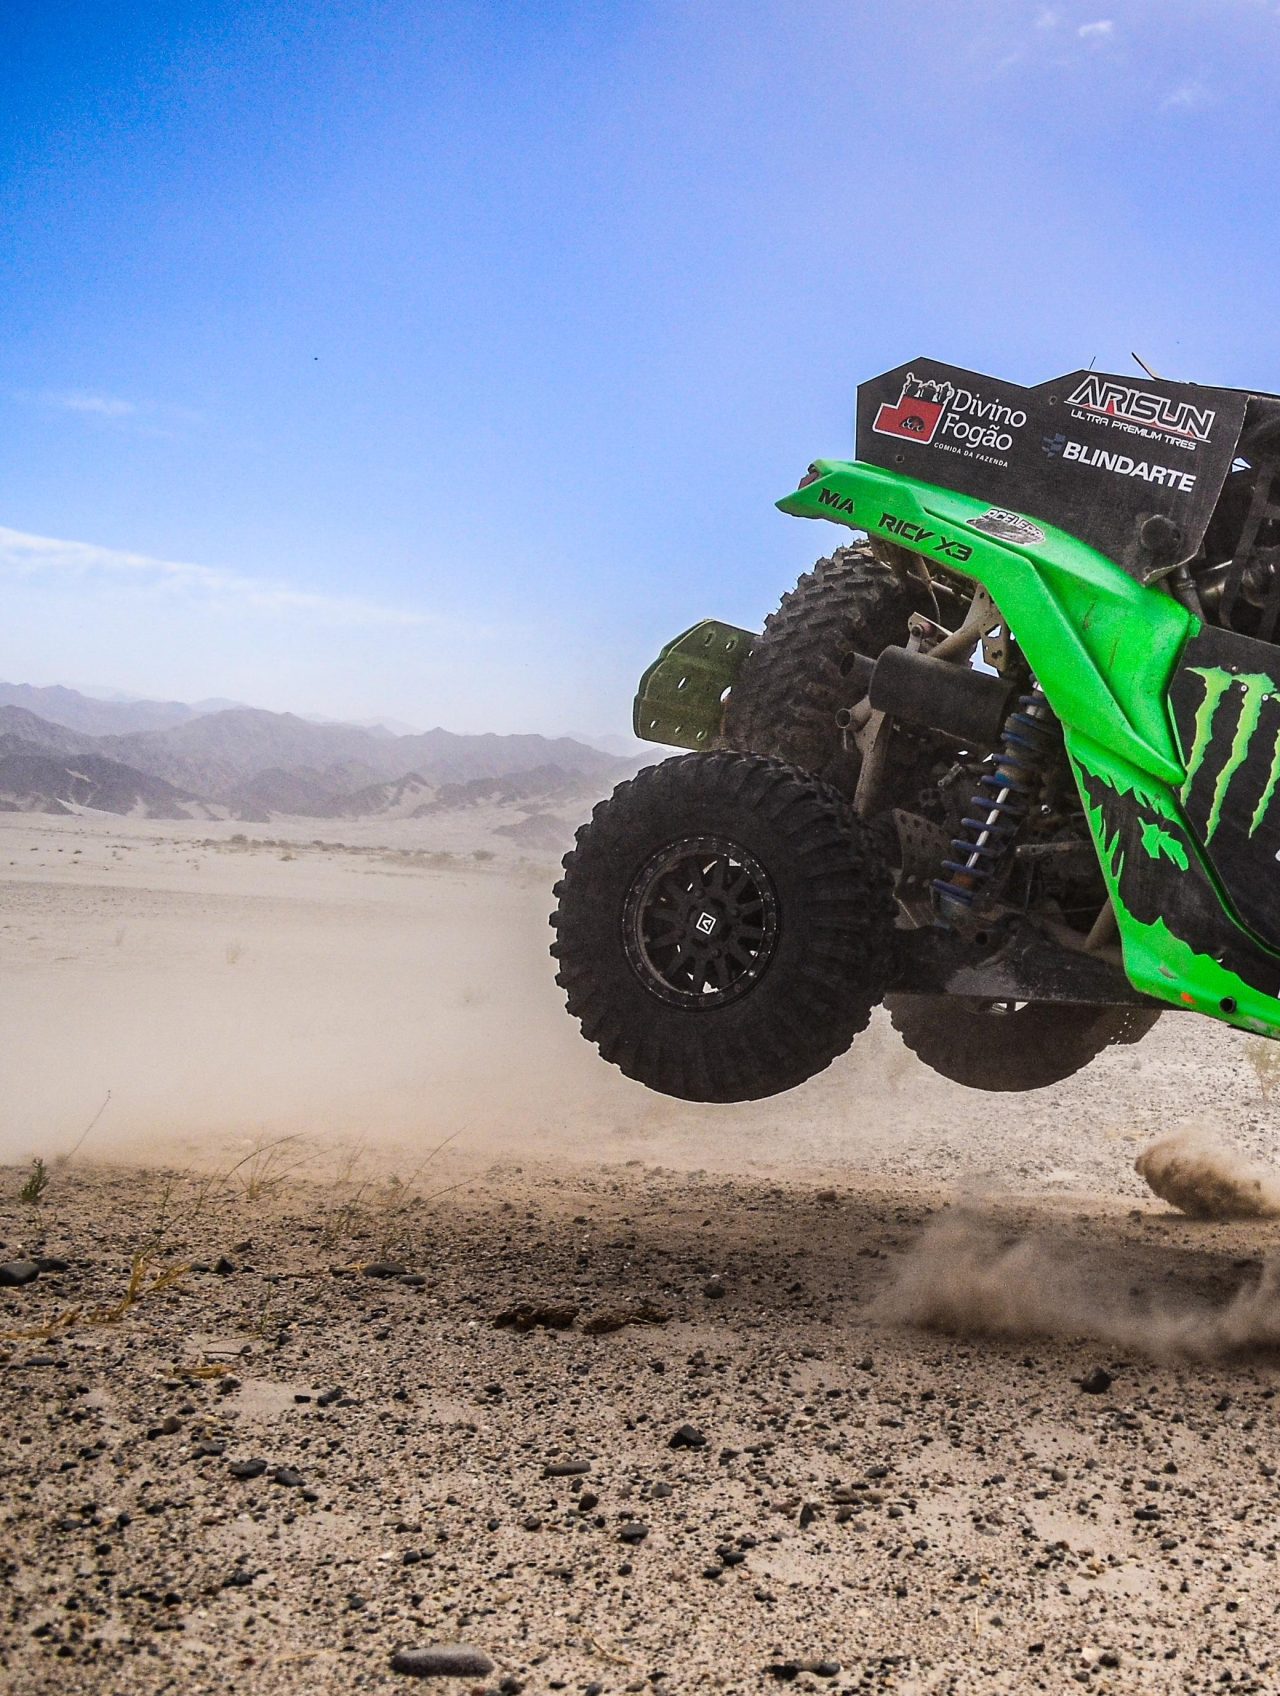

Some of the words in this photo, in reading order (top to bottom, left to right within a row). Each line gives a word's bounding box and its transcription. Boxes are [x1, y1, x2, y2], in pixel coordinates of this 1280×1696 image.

[952, 389, 1027, 427] Divino
[1067, 374, 1216, 440] ARISUN
[941, 412, 1013, 451] Fogão
[1070, 408, 1109, 426] ULTRA
[1111, 421, 1162, 441] PREMIUM
[1164, 434, 1197, 451] TIRES
[934, 442, 961, 454] COMIDA
[963, 450, 974, 458] DA
[975, 453, 1008, 468] FAZENDA
[1062, 441, 1197, 493] BLINDARTE
[932, 536, 974, 562] X3
